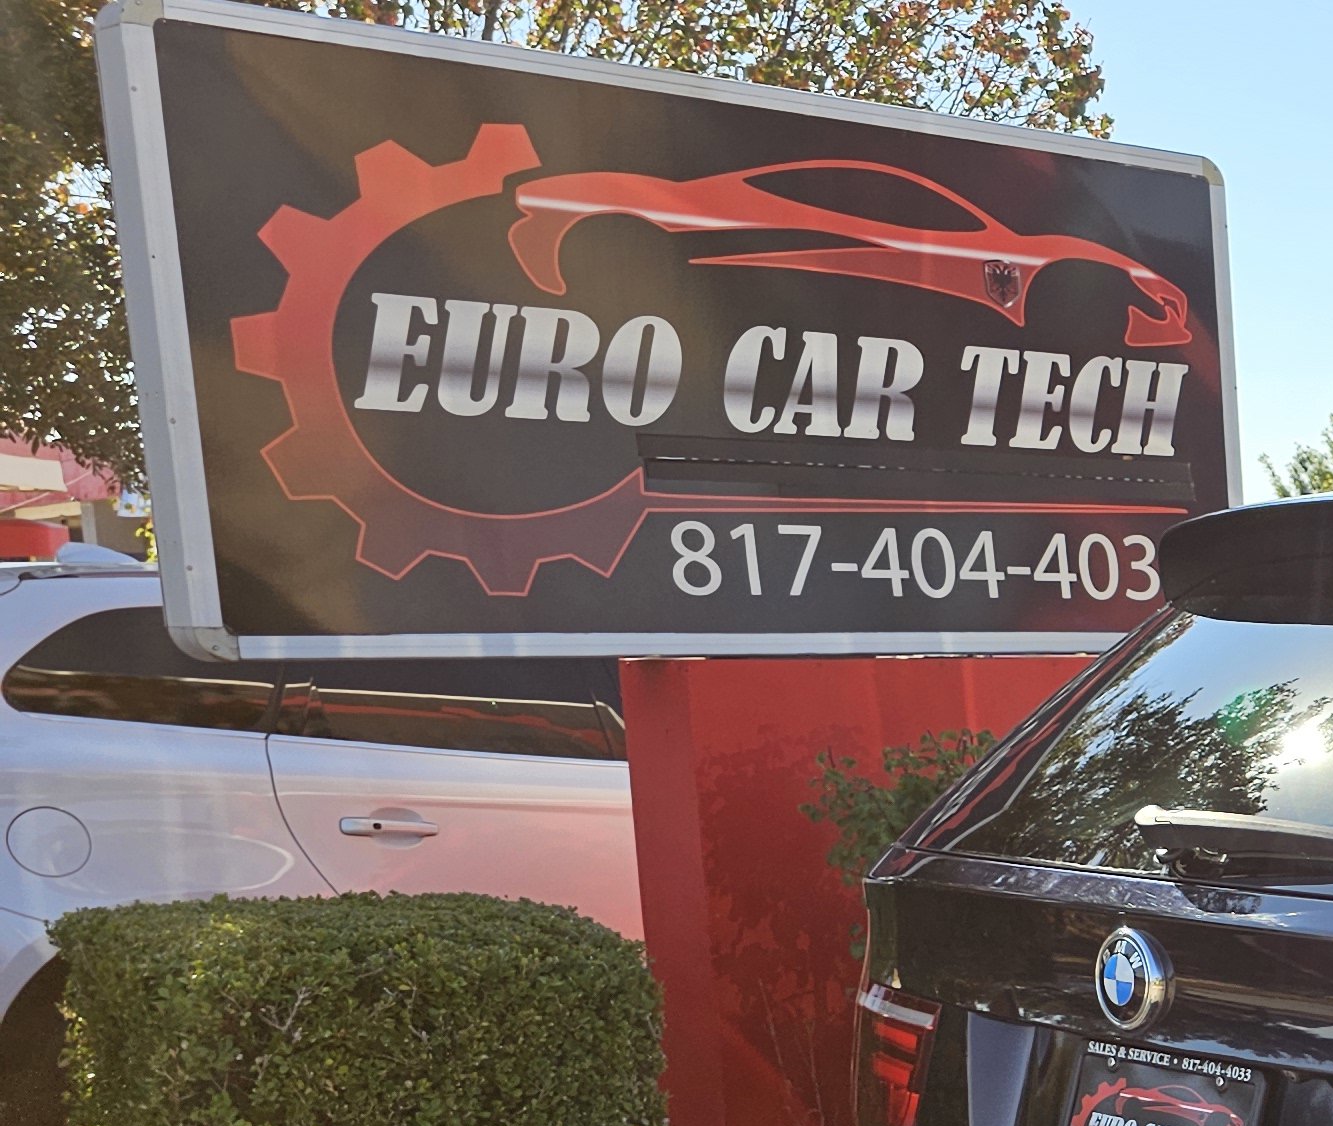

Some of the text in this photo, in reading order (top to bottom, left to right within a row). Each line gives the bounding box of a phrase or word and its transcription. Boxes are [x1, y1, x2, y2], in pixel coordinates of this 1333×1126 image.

[353, 291, 1189, 458] EURO CAR TECH
[671, 520, 1161, 601] 817-404-403
[1103, 940, 1143, 969] BMW
[1087, 1040, 1252, 1082] SALES & SERVICE 817-404-4033
